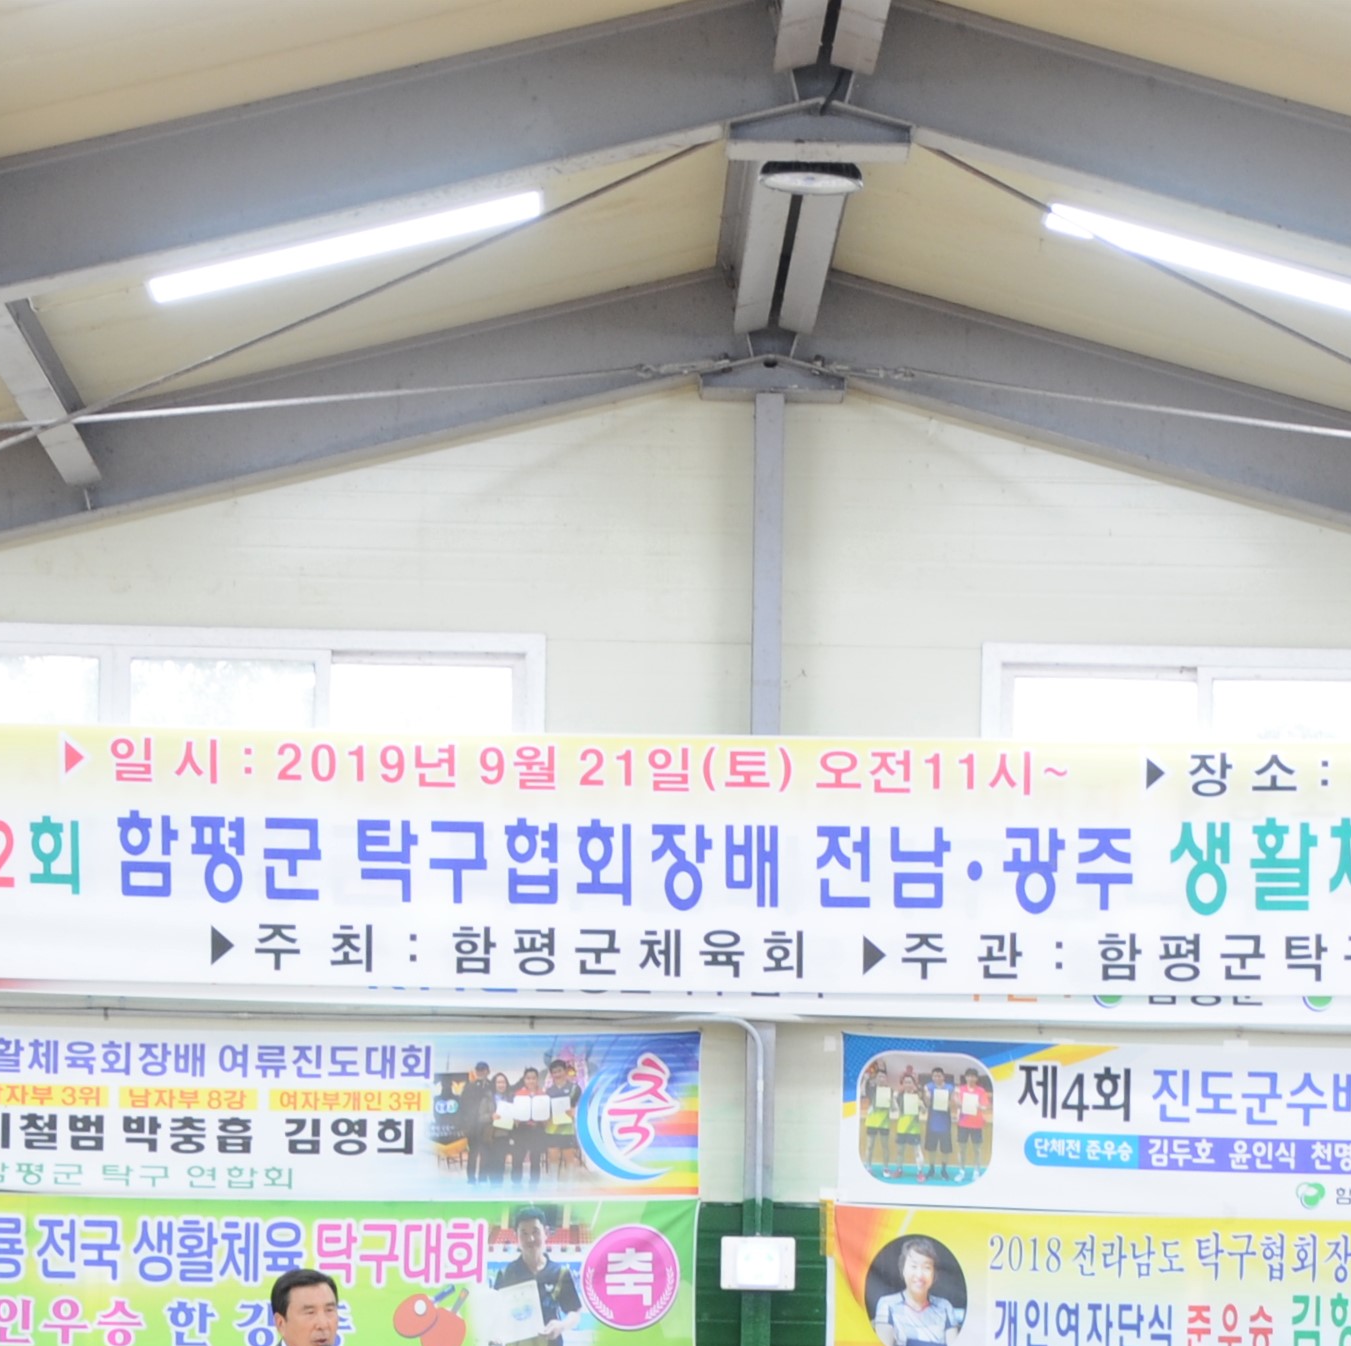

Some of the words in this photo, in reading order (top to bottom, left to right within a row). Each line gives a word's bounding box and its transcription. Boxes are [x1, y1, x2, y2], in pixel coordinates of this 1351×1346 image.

[276, 742, 456, 788] 2019년
[479, 744, 557, 791] 9월
[579, 746, 794, 793] 21일(토)
[117, 810, 322, 904] 함평군
[356, 817, 779, 912] 탁구협회장배
[60, 1085, 102, 1107] 3위
[128, 1087, 200, 1109] 남자부
[207, 1089, 248, 1110] 8강
[1016, 1063, 1133, 1122] 제4회
[284, 1117, 415, 1156] 김영희
[1148, 1138, 1216, 1168] 김두호
[1228, 1141, 1297, 1171] 윤인식
[36, 1215, 122, 1281] 전국
[132, 1217, 305, 1284] 생활체육
[315, 1220, 485, 1286] 탁구대회
[989, 1233, 1062, 1274] 2018
[1072, 1233, 1185, 1279] 전라남도
[603, 1246, 655, 1307] 축
